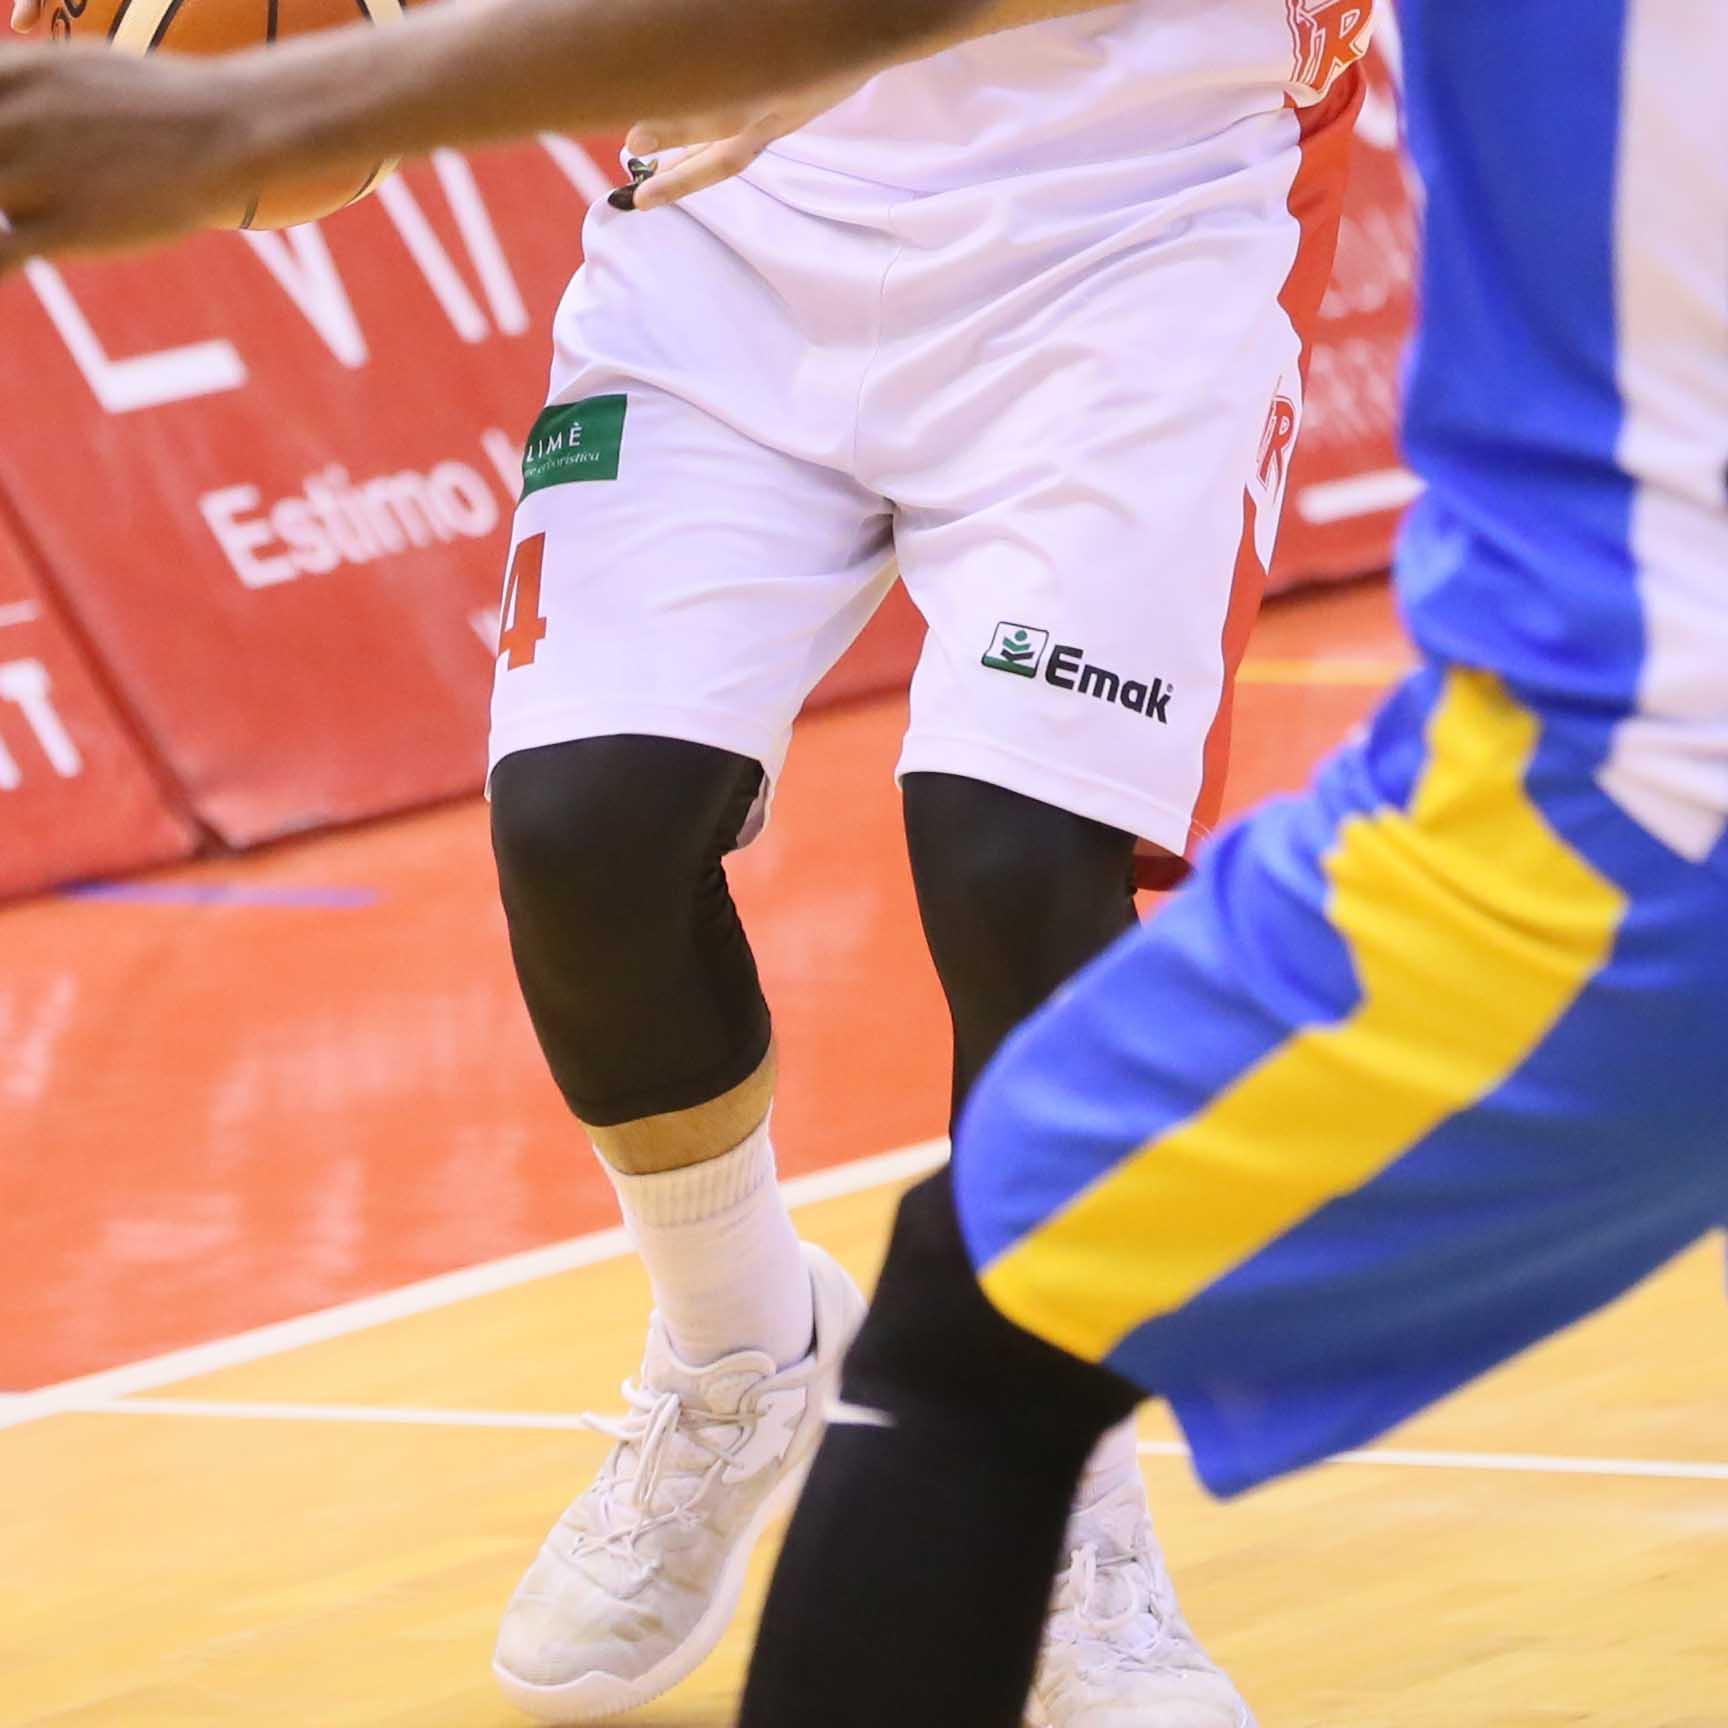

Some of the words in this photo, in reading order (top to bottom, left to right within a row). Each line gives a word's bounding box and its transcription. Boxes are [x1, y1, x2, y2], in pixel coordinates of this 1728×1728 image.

[526, 421, 583, 464] LIMÈ
[198, 458, 500, 590] Estimo
[498, 531, 547, 672] 4
[1045, 644, 1171, 725] Emak
